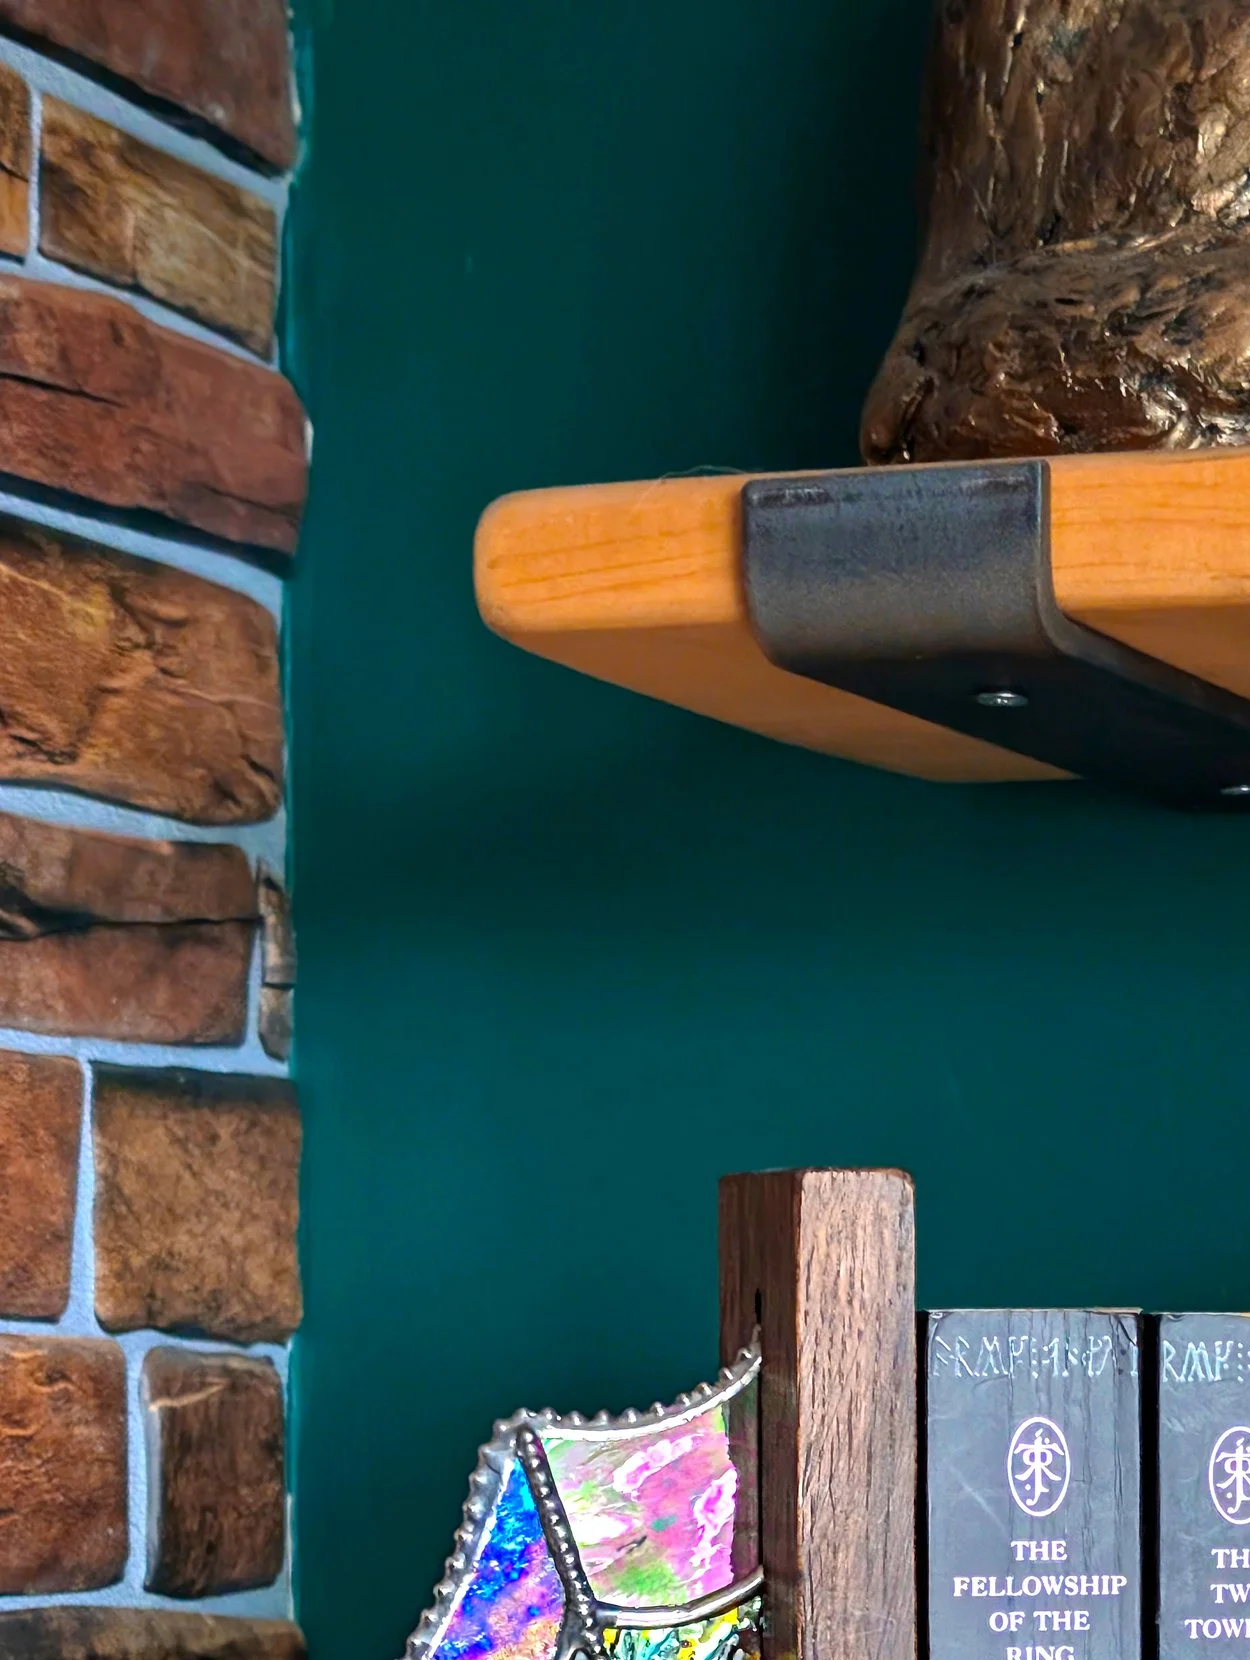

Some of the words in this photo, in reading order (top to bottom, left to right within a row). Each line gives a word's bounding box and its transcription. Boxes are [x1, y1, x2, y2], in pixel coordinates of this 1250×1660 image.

[1010, 1539, 1068, 1562] THE
[953, 1574, 1128, 1598] FELLOWSHIP
[989, 1611, 1026, 1633] OF
[1033, 1610, 1091, 1632] THE
